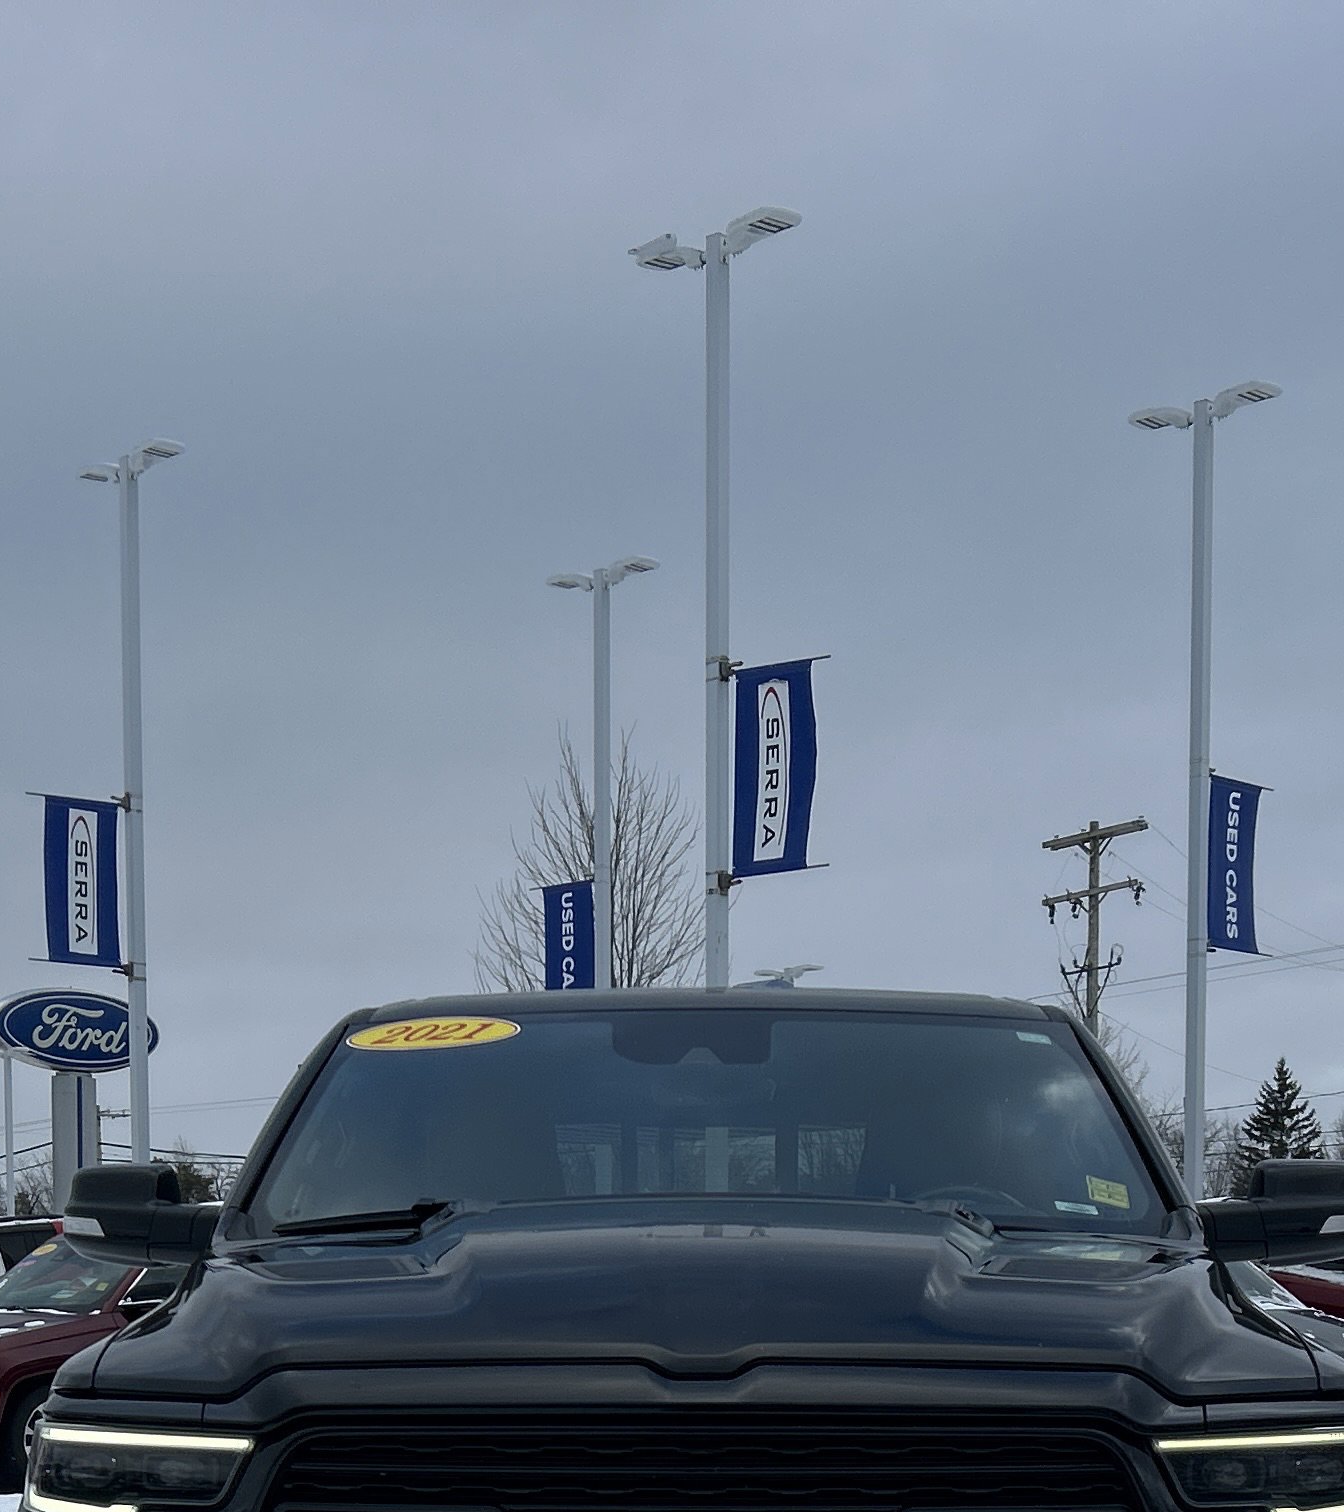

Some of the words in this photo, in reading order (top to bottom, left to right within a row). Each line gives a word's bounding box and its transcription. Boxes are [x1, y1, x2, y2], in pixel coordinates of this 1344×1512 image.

[761, 717, 780, 848] SERRA
[1225, 791, 1242, 863] USED
[74, 839, 89, 943] SERRA
[561, 892, 574, 951] USED
[1225, 869, 1239, 939] CARS
[562, 956, 575, 990] CA
[31, 1003, 128, 1054] Ford
[370, 1022, 496, 1045] 2021
